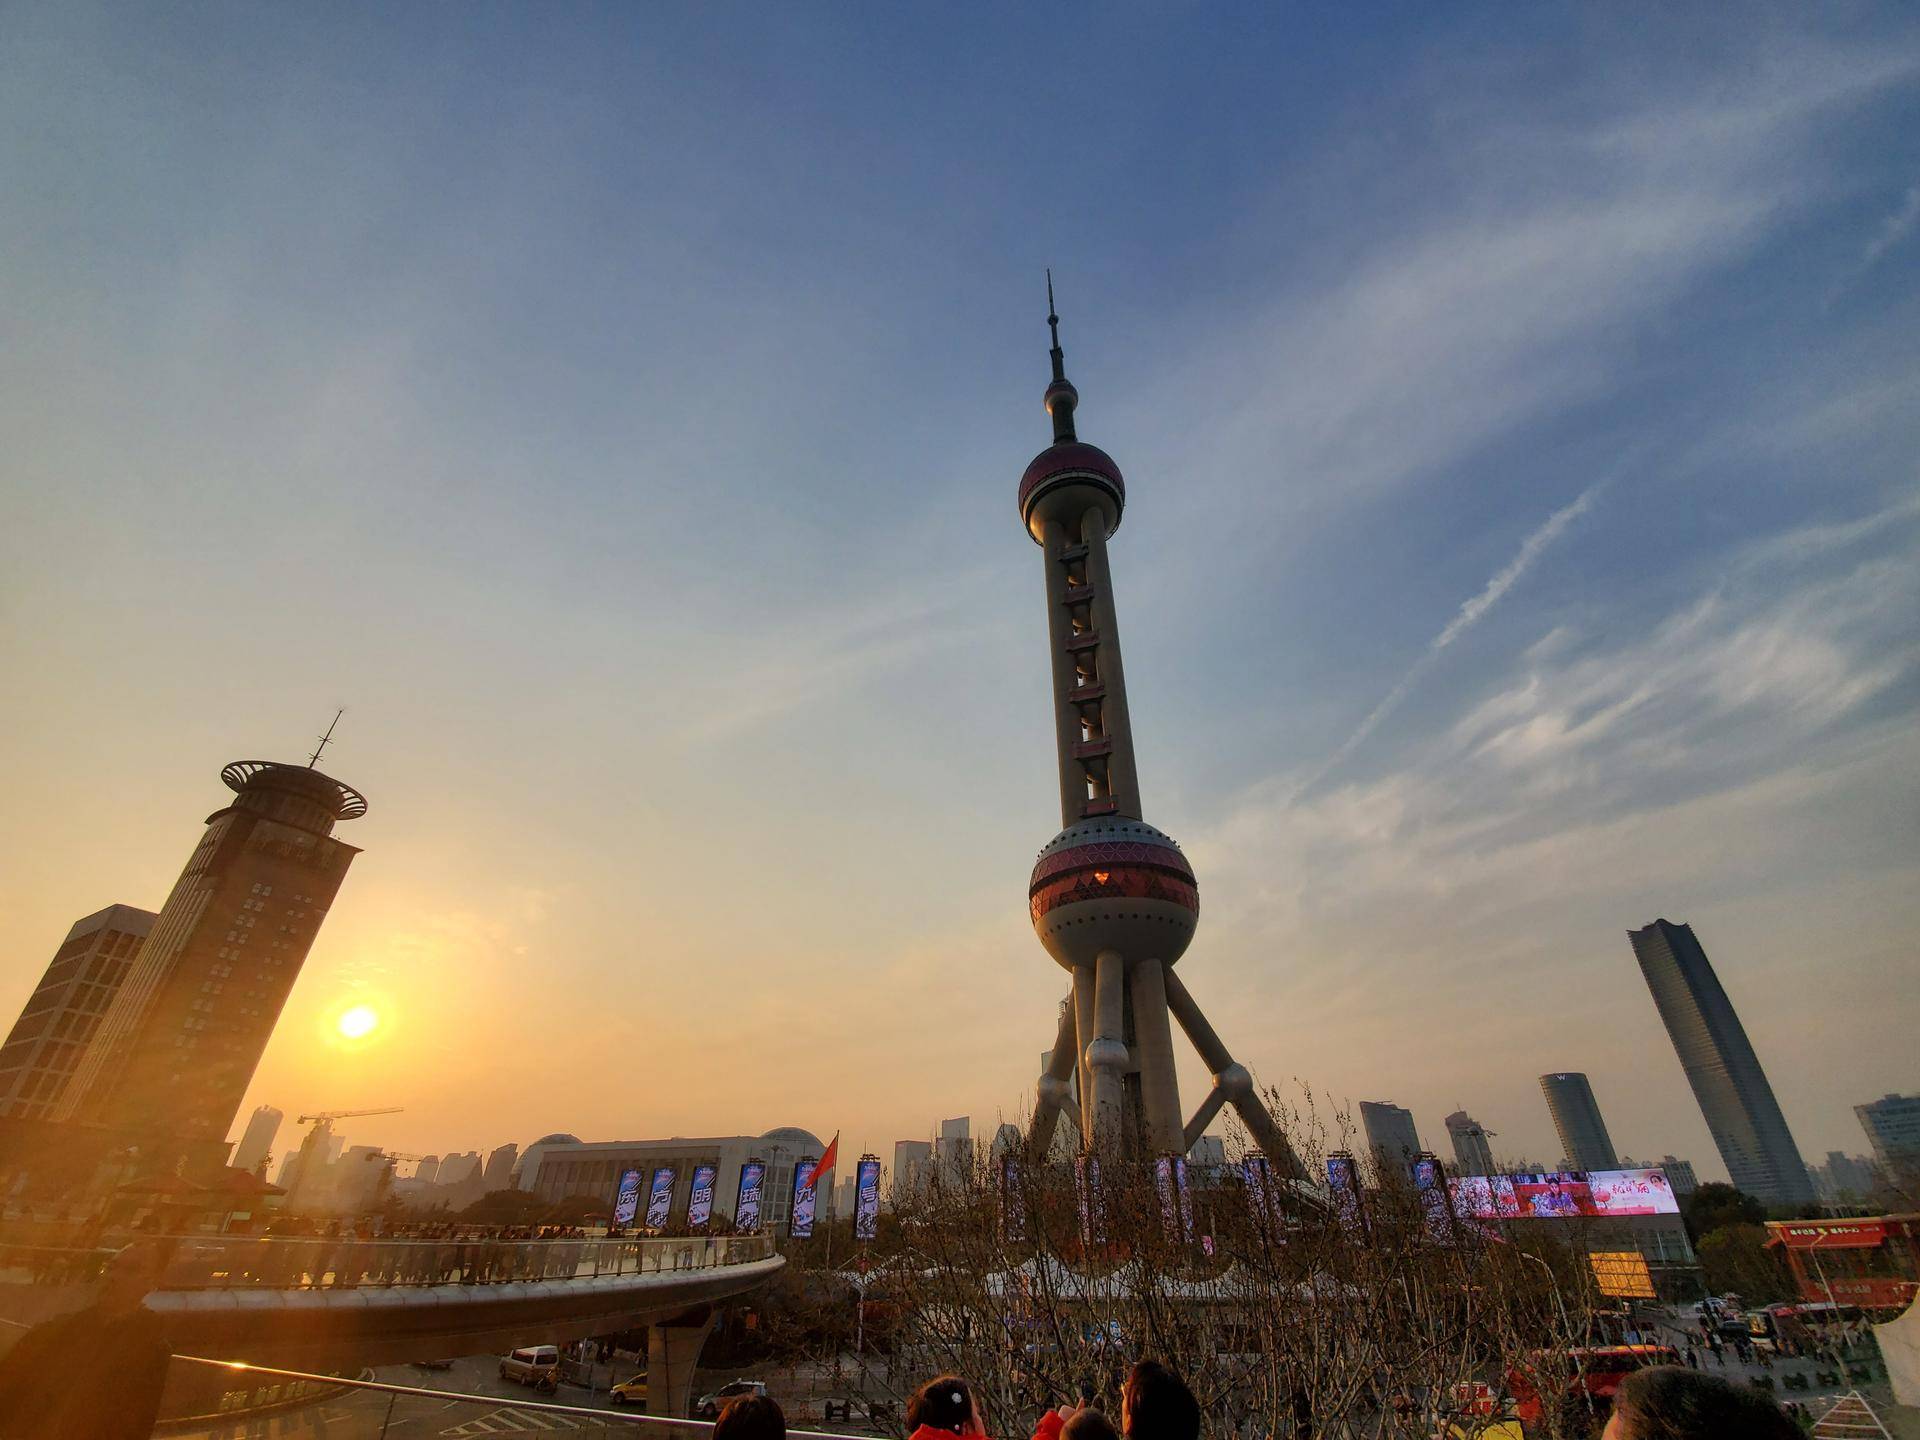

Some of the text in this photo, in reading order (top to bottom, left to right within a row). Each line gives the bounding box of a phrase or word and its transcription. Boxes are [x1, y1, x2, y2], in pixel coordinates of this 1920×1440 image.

[620, 1190, 637, 1204] 东
[652, 1189, 670, 1204] 方
[693, 1187, 712, 1204] 明
[797, 1186, 814, 1203] 九
[861, 1186, 877, 1203] 号
